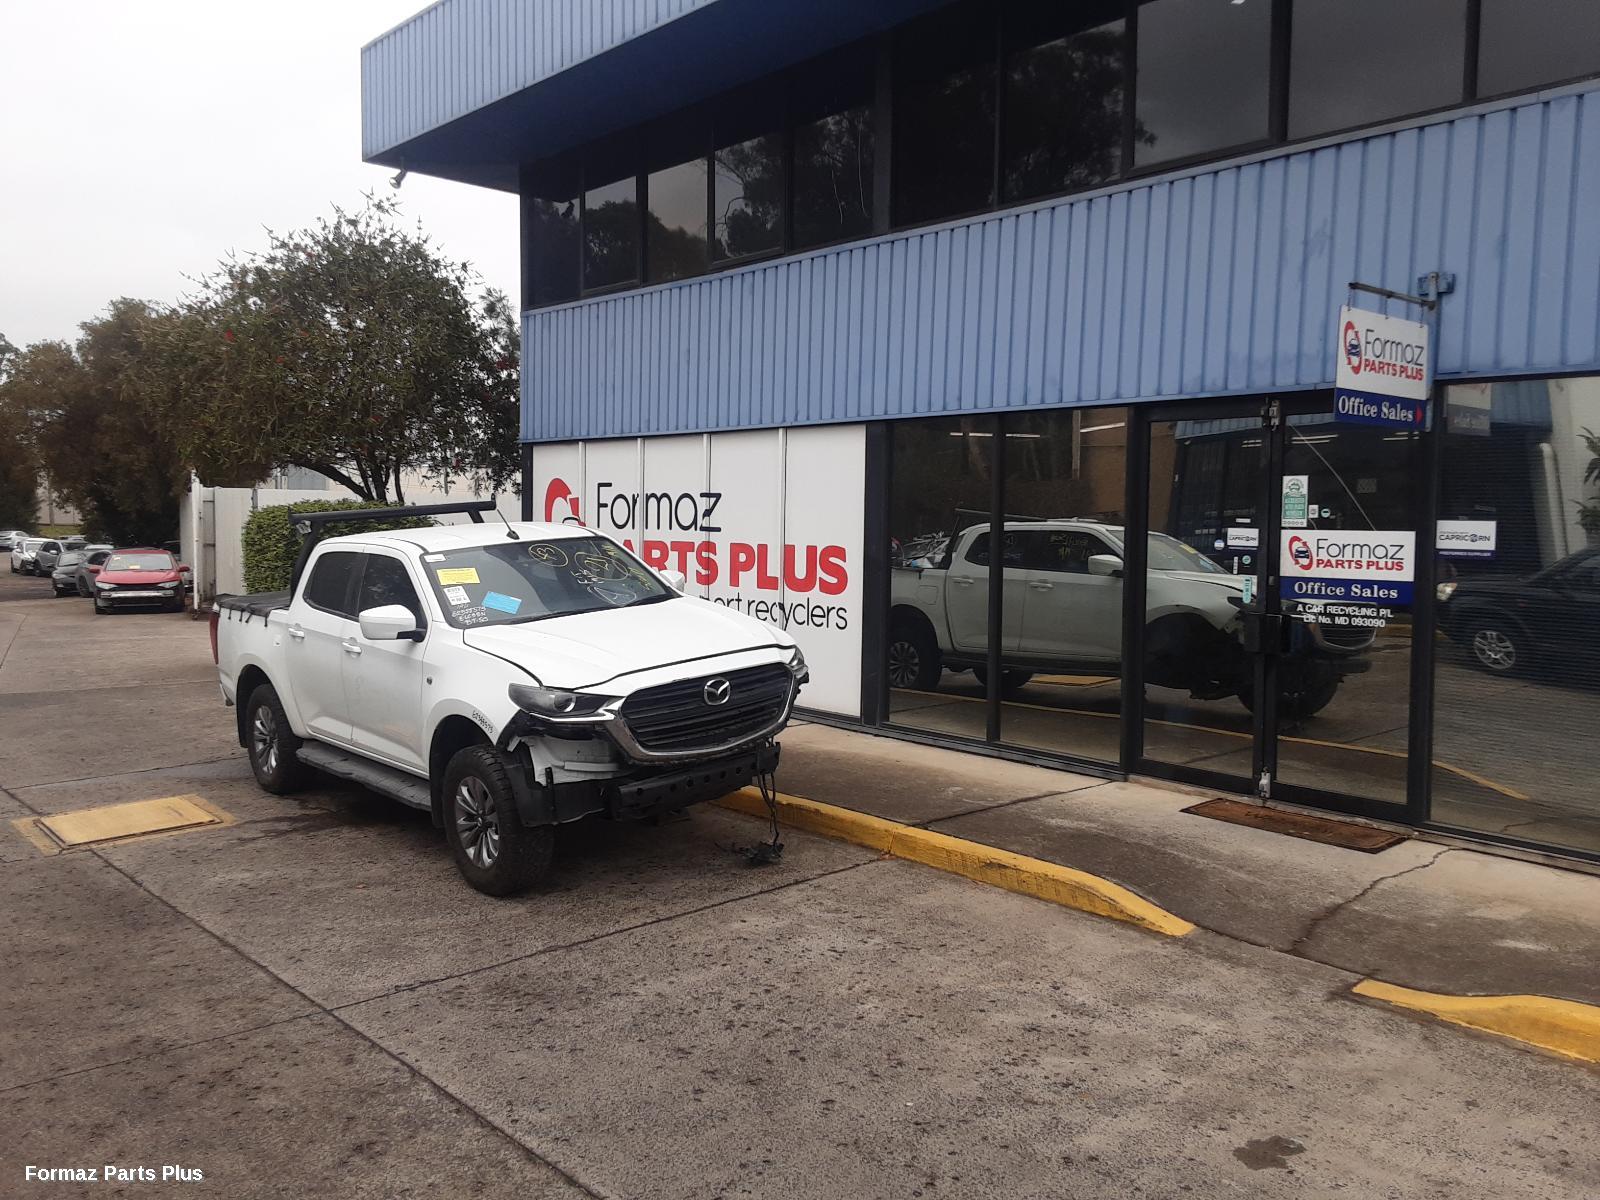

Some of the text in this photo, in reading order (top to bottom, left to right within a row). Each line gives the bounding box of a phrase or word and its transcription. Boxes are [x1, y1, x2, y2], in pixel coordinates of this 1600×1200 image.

[1364, 328, 1425, 367] Formaz
[1363, 358, 1424, 381] PARTS PLUS
[1338, 395, 1414, 422] Office Sales
[597, 482, 722, 532] Formaz
[1316, 538, 1405, 561] Formaz
[623, 540, 719, 585] RTS
[729, 542, 849, 596] PLUS
[1316, 558, 1404, 571] PARTS PLUS
[1294, 582, 1398, 599] Office Sales
[748, 597, 848, 632] recyclers
[1297, 604, 1304, 612] A
[1305, 604, 1324, 614] CAR
[1326, 605, 1377, 617] RECYCLING
[1318, 616, 1333, 624] No.
[1334, 616, 1349, 625] MD
[1351, 617, 1386, 628] 093090
